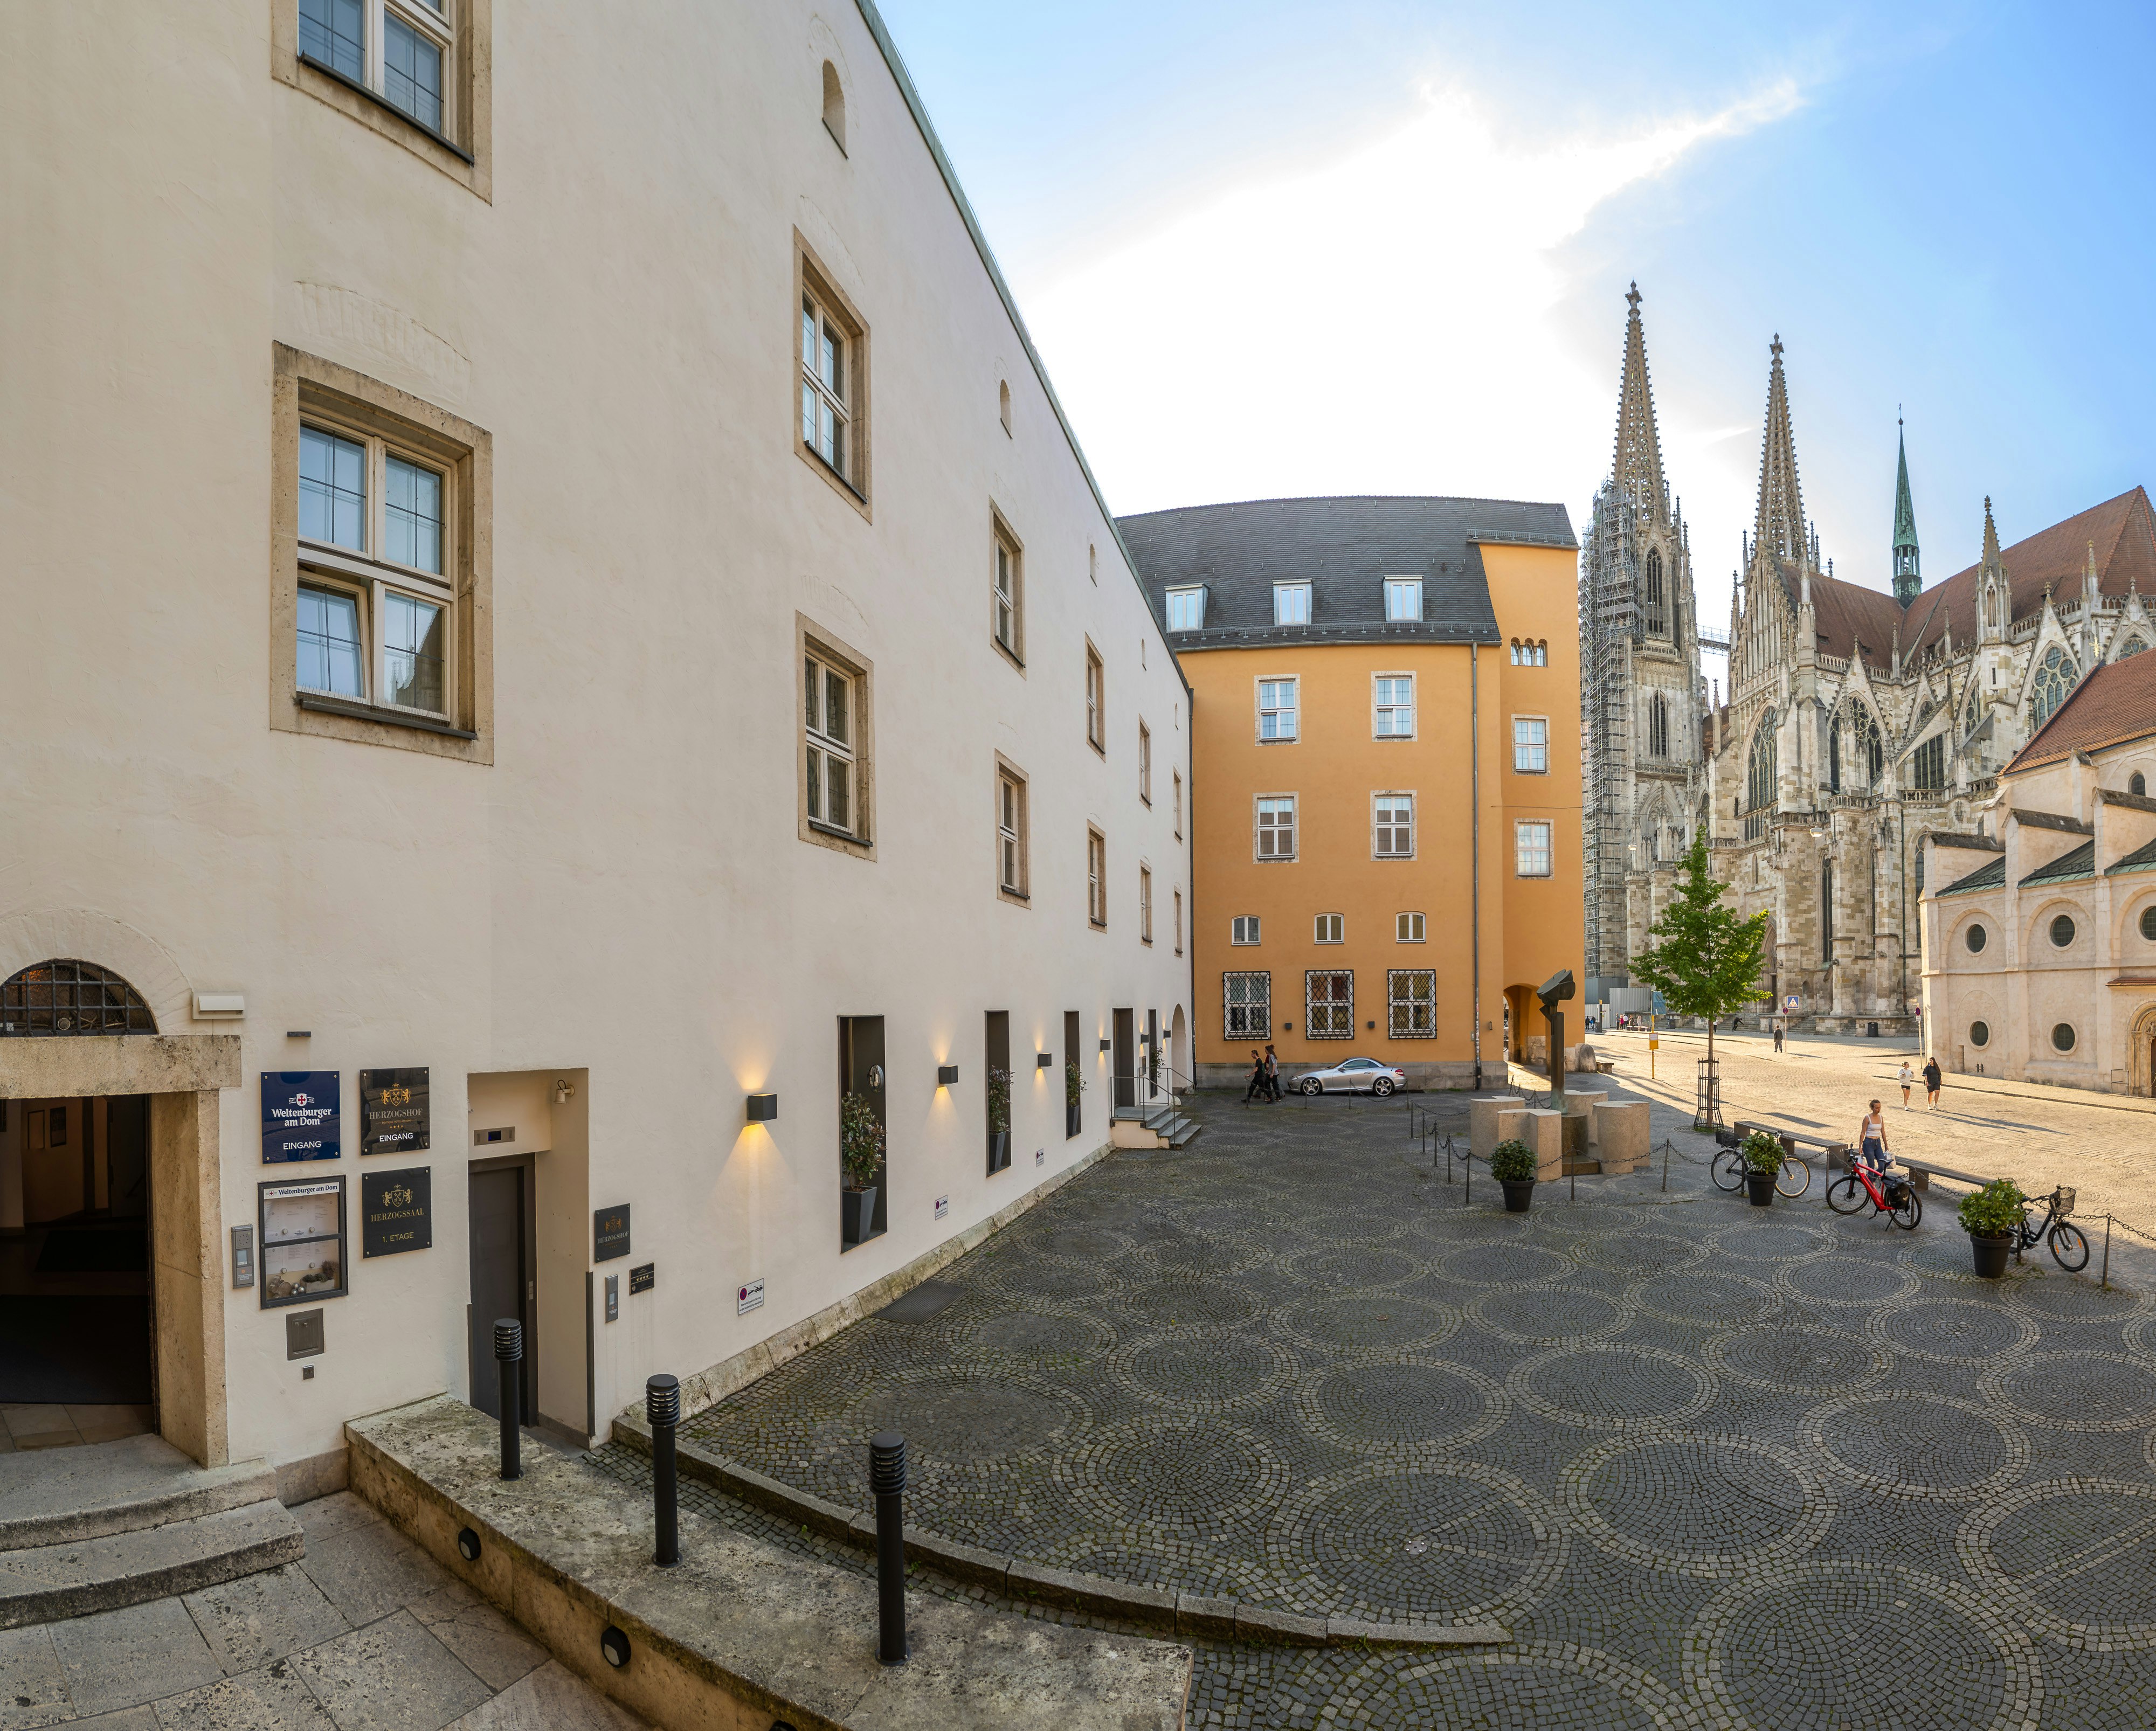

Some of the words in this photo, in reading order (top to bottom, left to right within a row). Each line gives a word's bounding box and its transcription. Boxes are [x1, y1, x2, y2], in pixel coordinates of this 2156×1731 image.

[271, 1108, 332, 1118] Weltenburger
[369, 1109, 423, 1119] HERZOGSHOF
[300, 1117, 321, 1126] Dom
[379, 1132, 413, 1142] EINGANG
[283, 1141, 321, 1150] EINGANG
[278, 1187, 315, 1195] Weltenburger
[371, 1208, 425, 1222] HERZOGSSAAL
[390, 1231, 414, 1242] ETAGE
[597, 1231, 630, 1244] HERZOGSHOF
